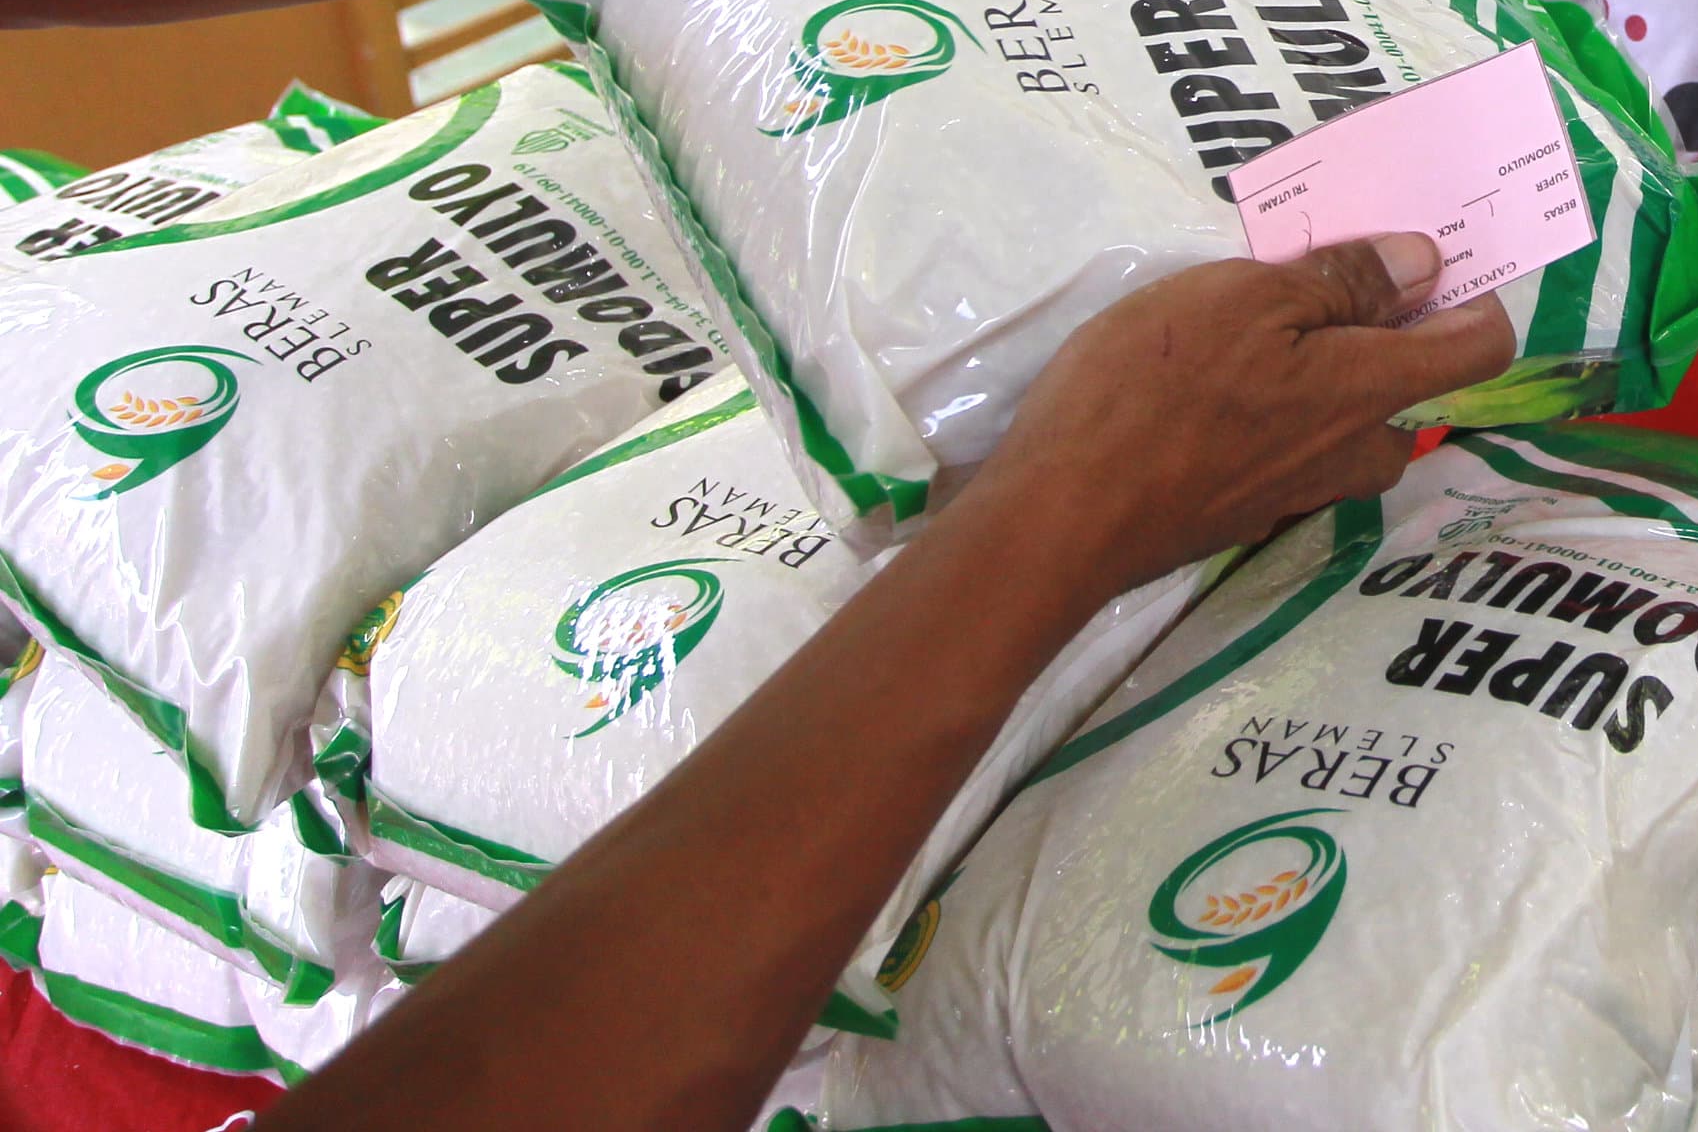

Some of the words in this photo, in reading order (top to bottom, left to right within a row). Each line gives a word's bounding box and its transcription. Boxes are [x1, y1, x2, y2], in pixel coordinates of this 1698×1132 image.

[1498, 140, 1561, 177] SIDOMULYO
[1258, 189, 1291, 214] UTAMI
[1290, 182, 1309, 196] TRI
[1536, 170, 1570, 193] SUPER
[1437, 219, 1465, 238] PACK
[1543, 199, 1577, 221] BERAS
[1443, 248, 1473, 268] Nama
[1441, 260, 1517, 305] GAPOKTAN
[190, 279, 346, 383] BERAS
[230, 266, 372, 358] SLEMAN
[364, 236, 588, 384] SUPER
[650, 494, 831, 571] BERAS
[1386, 617, 1674, 754] SUPER
[1241, 716, 1455, 765] SLEMAN
[1211, 736, 1441, 809] BERAS
